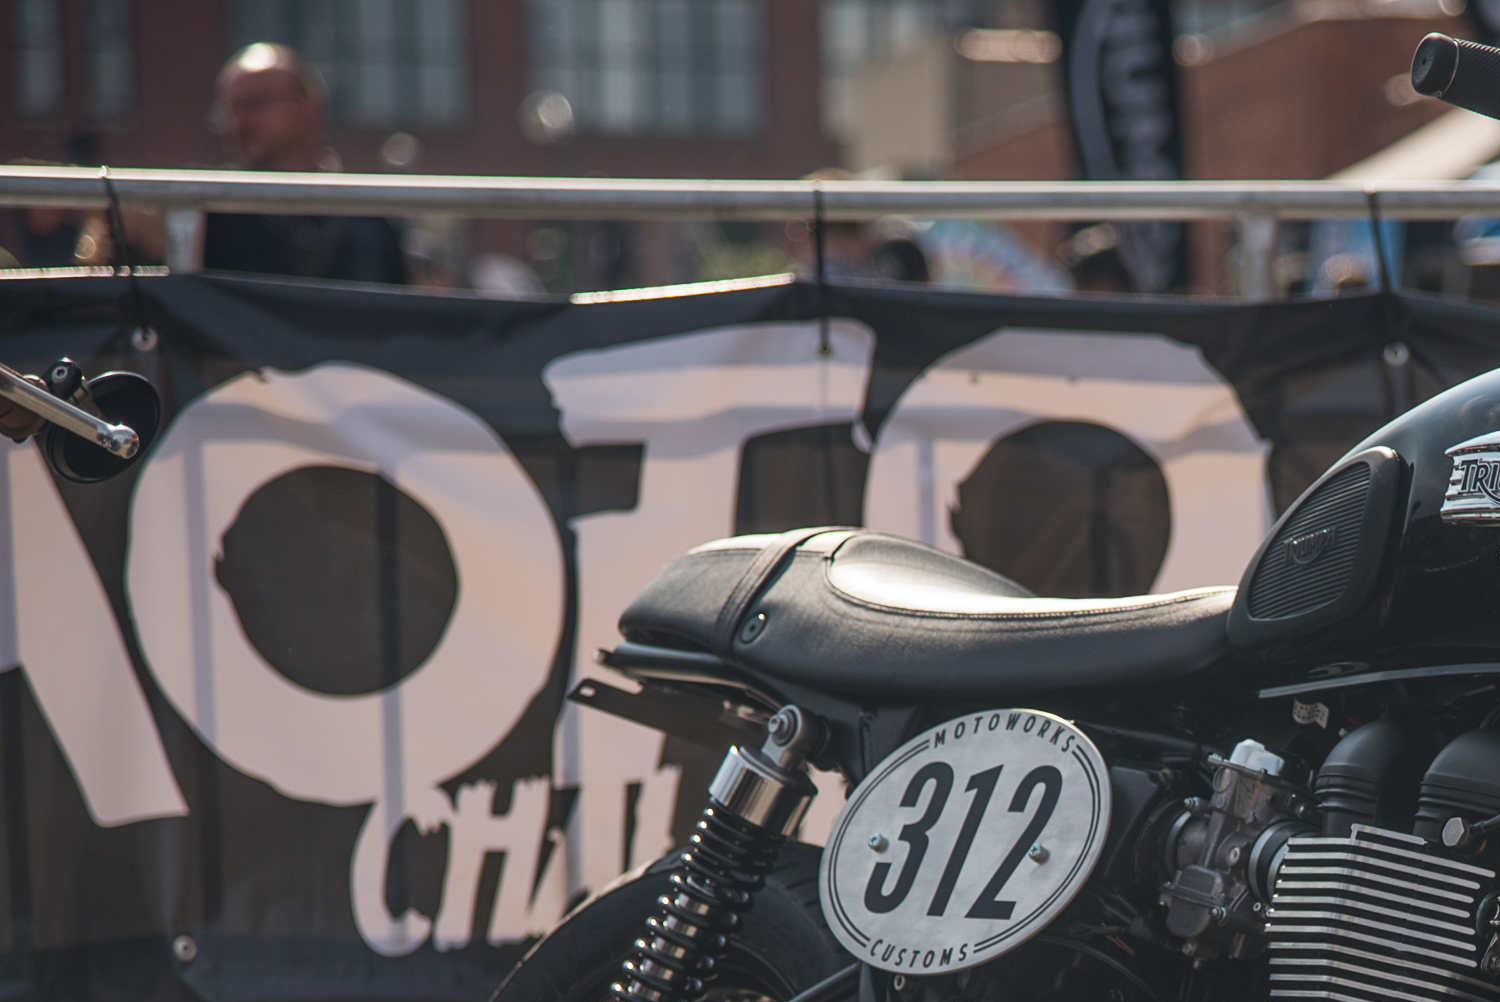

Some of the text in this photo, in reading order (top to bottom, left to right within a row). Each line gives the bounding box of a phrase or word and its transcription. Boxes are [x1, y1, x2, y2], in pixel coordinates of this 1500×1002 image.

[933, 712, 1076, 753] MOTOWORKS
[863, 761, 1064, 921] 312
[869, 939, 969, 969] CUSTOMS
